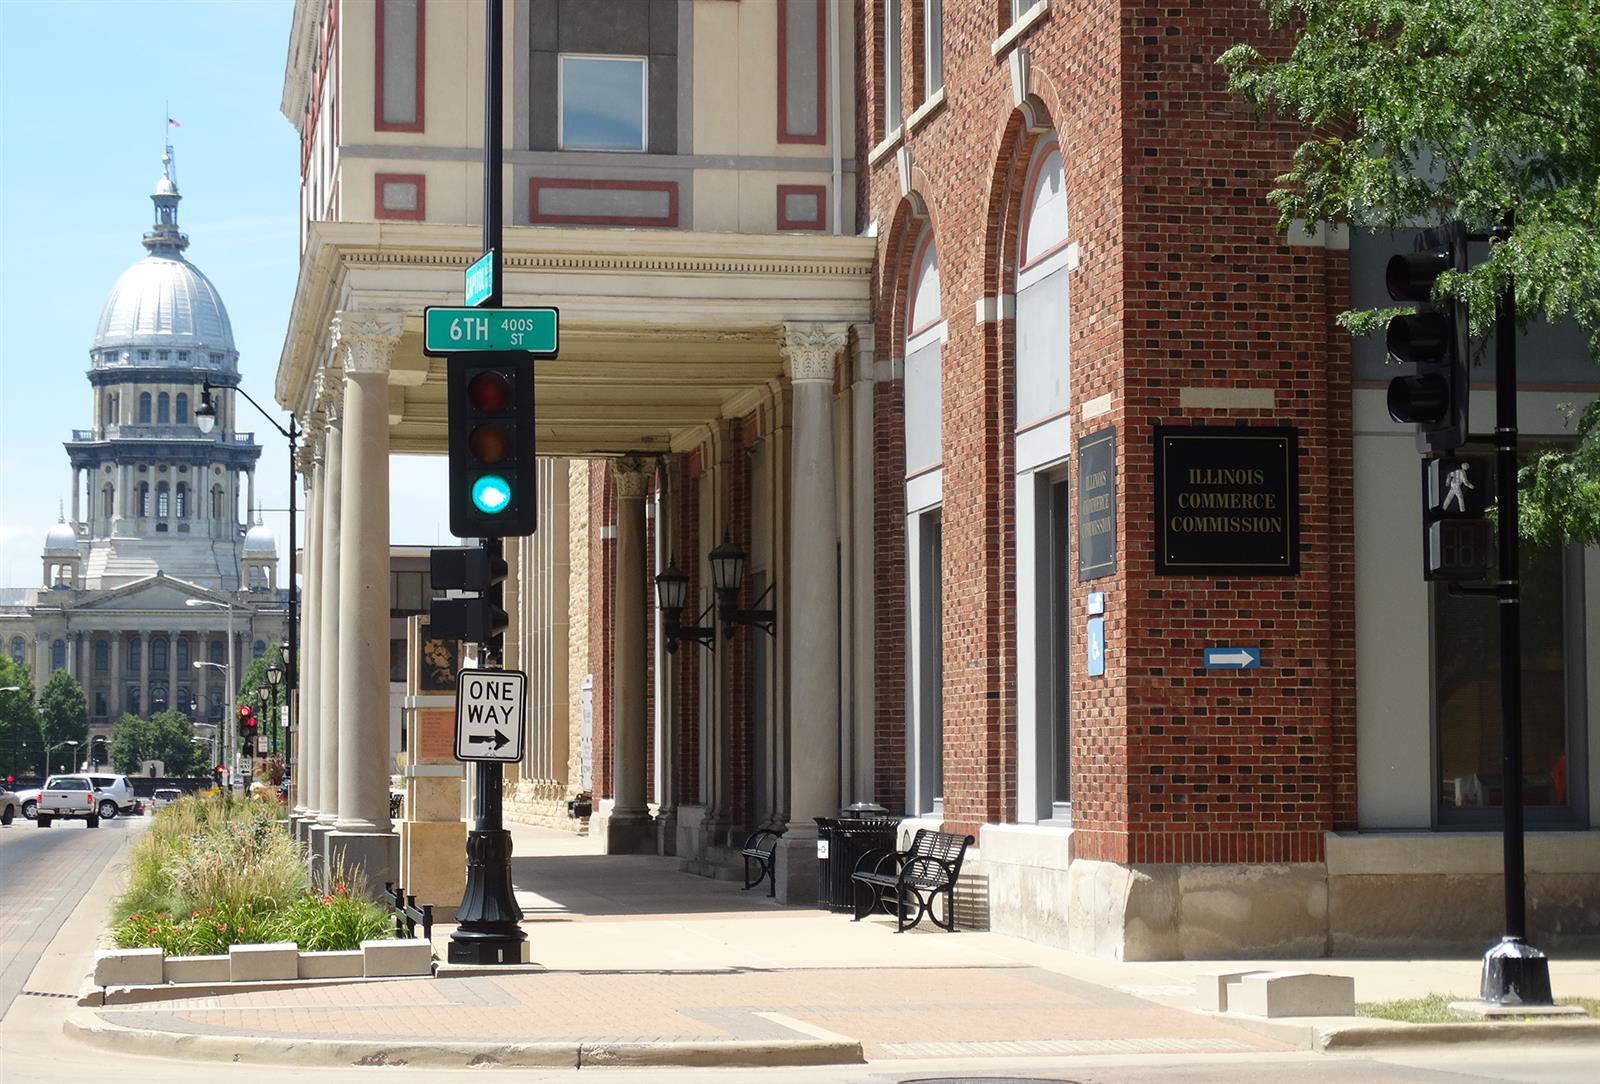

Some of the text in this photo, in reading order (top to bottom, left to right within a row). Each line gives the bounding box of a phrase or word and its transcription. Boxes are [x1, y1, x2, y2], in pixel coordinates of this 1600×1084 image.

[450, 318, 533, 341] 6TH 400S
[510, 333, 524, 346] ST
[1189, 469, 1264, 485] ILLINOIS
[1178, 492, 1276, 510] COMMERCE
[1171, 516, 1282, 533] COMMISSION
[469, 681, 514, 701] ONE
[468, 705, 514, 724] WAY
